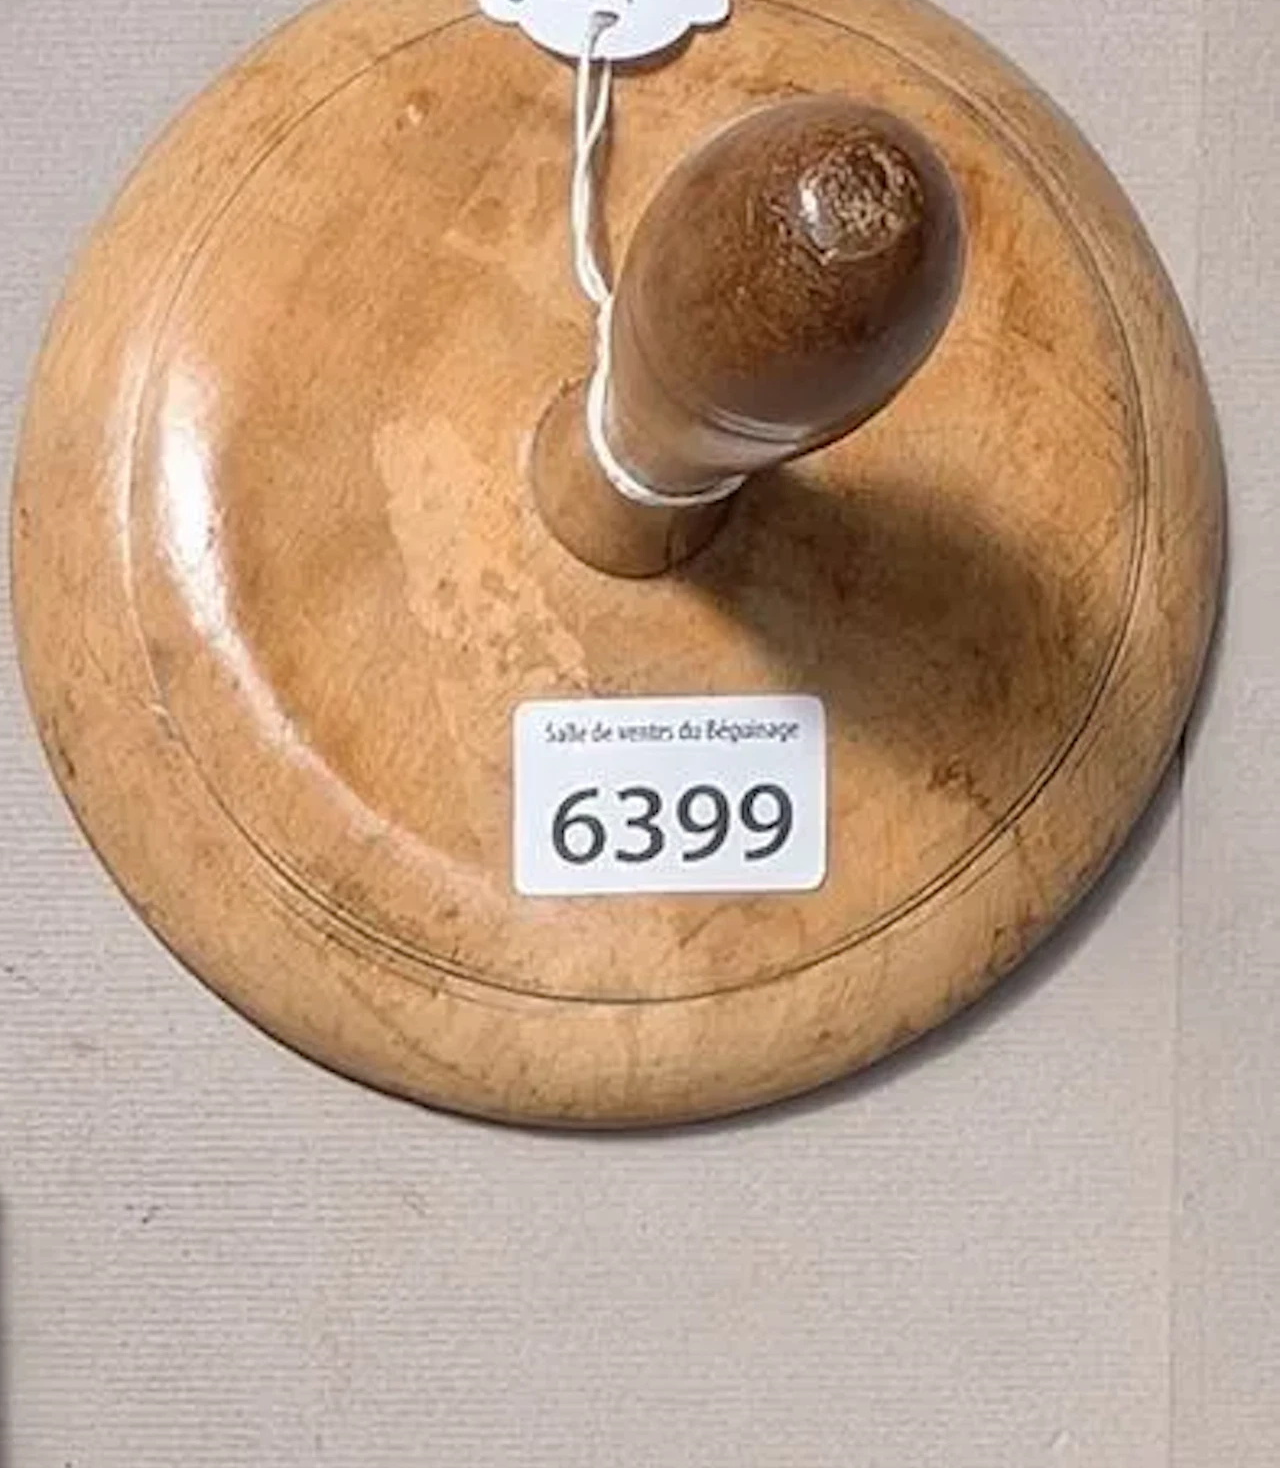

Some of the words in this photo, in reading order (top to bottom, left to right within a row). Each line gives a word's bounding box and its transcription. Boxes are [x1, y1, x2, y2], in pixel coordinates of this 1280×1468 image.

[544, 721, 586, 743] Salle
[591, 720, 612, 742] de
[619, 723, 674, 741] ventes
[678, 719, 702, 739] du
[706, 717, 800, 743] Béguinage
[552, 783, 794, 865] 6399
